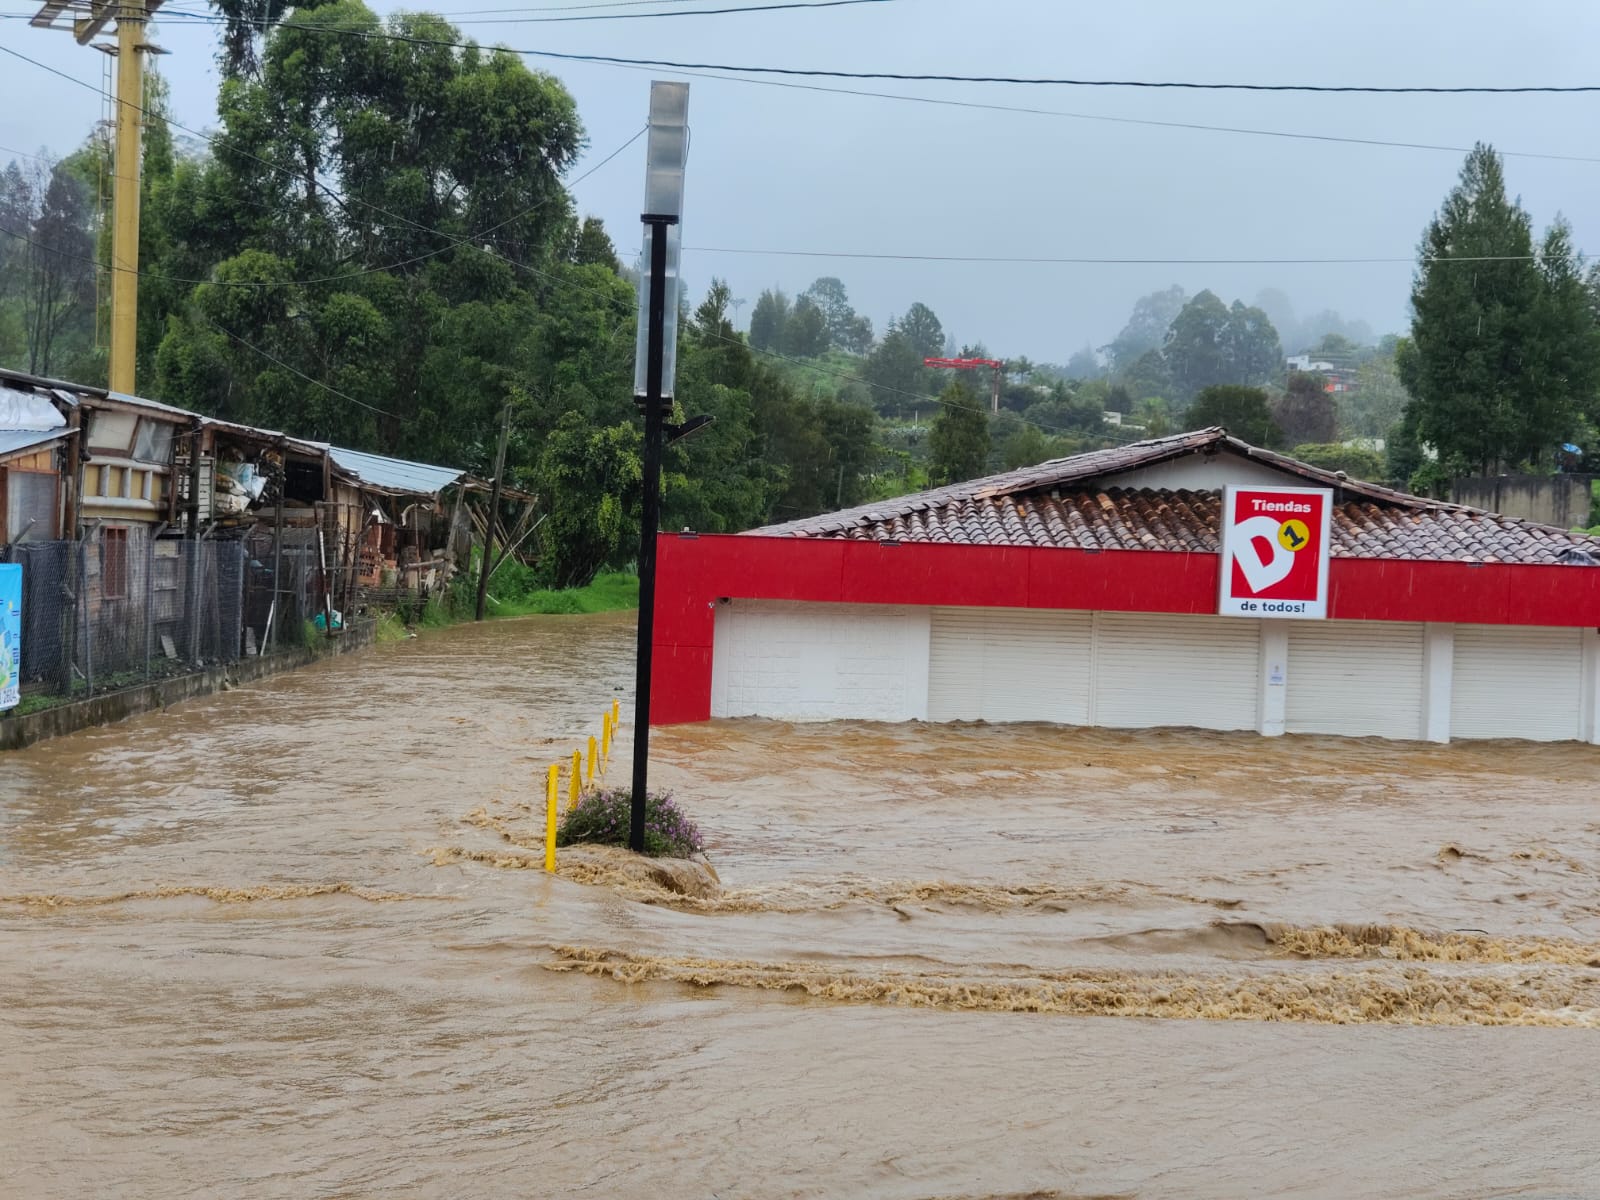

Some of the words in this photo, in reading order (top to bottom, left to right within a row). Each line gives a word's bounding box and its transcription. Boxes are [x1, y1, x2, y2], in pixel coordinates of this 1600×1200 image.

[1251, 499, 1312, 513] Tiendas
[1240, 601, 1258, 611] de
[1262, 602, 1306, 613] todos!
